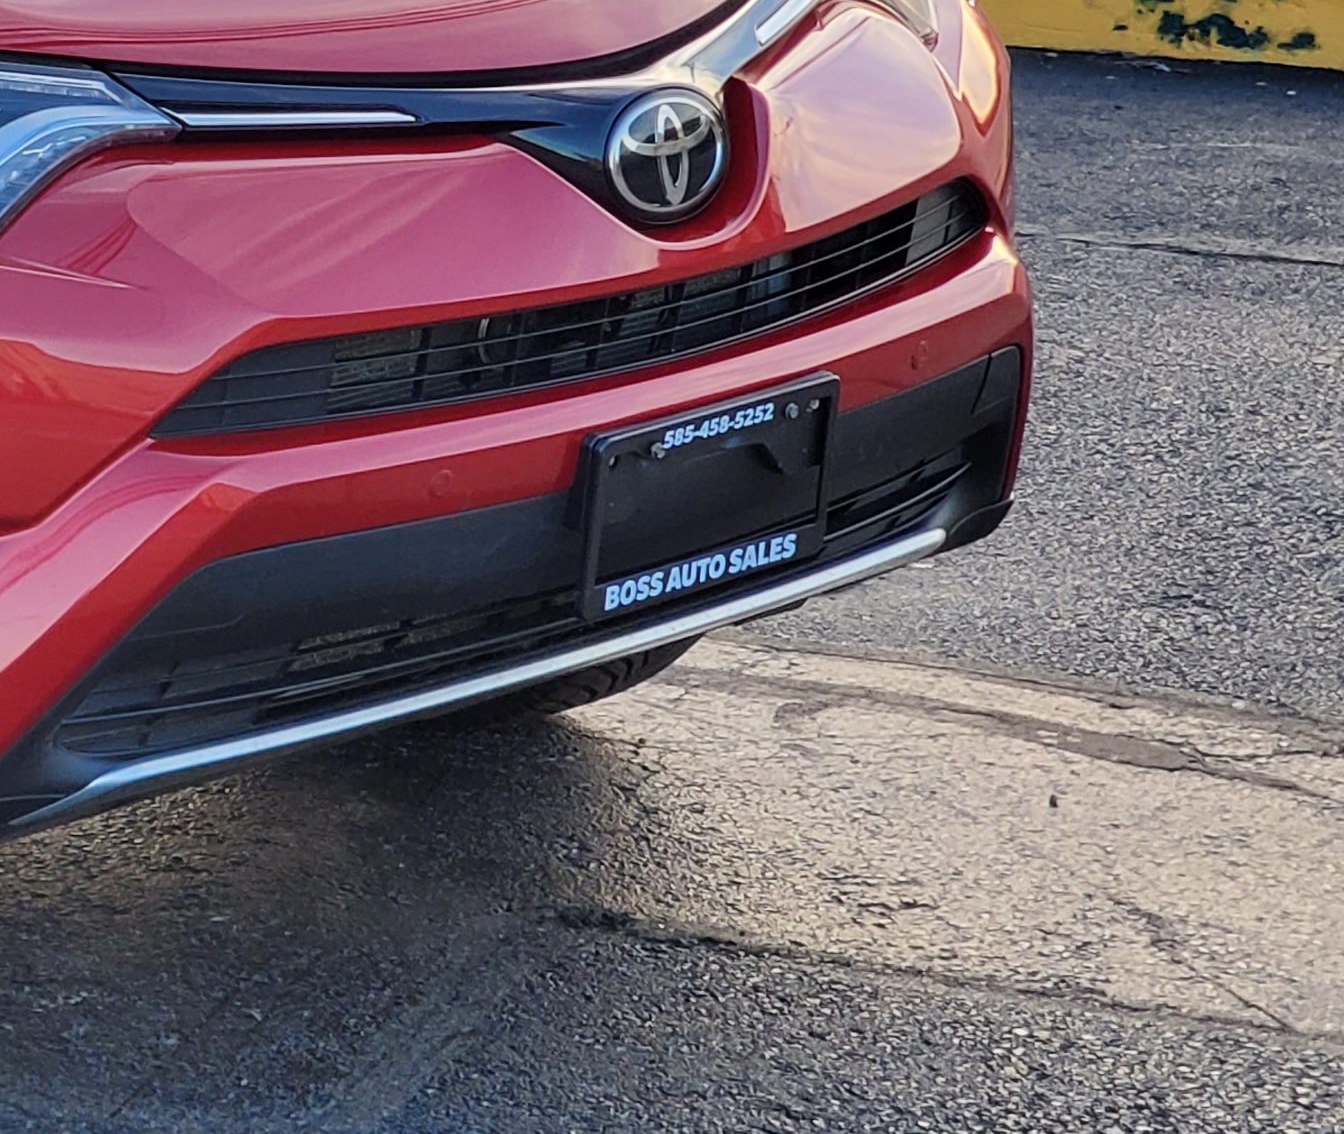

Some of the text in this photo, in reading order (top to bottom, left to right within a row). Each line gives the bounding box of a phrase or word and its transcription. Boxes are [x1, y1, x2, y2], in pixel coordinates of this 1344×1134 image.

[662, 401, 776, 450] 585-458-5252
[603, 533, 798, 611] BOSS AUTO SALES
